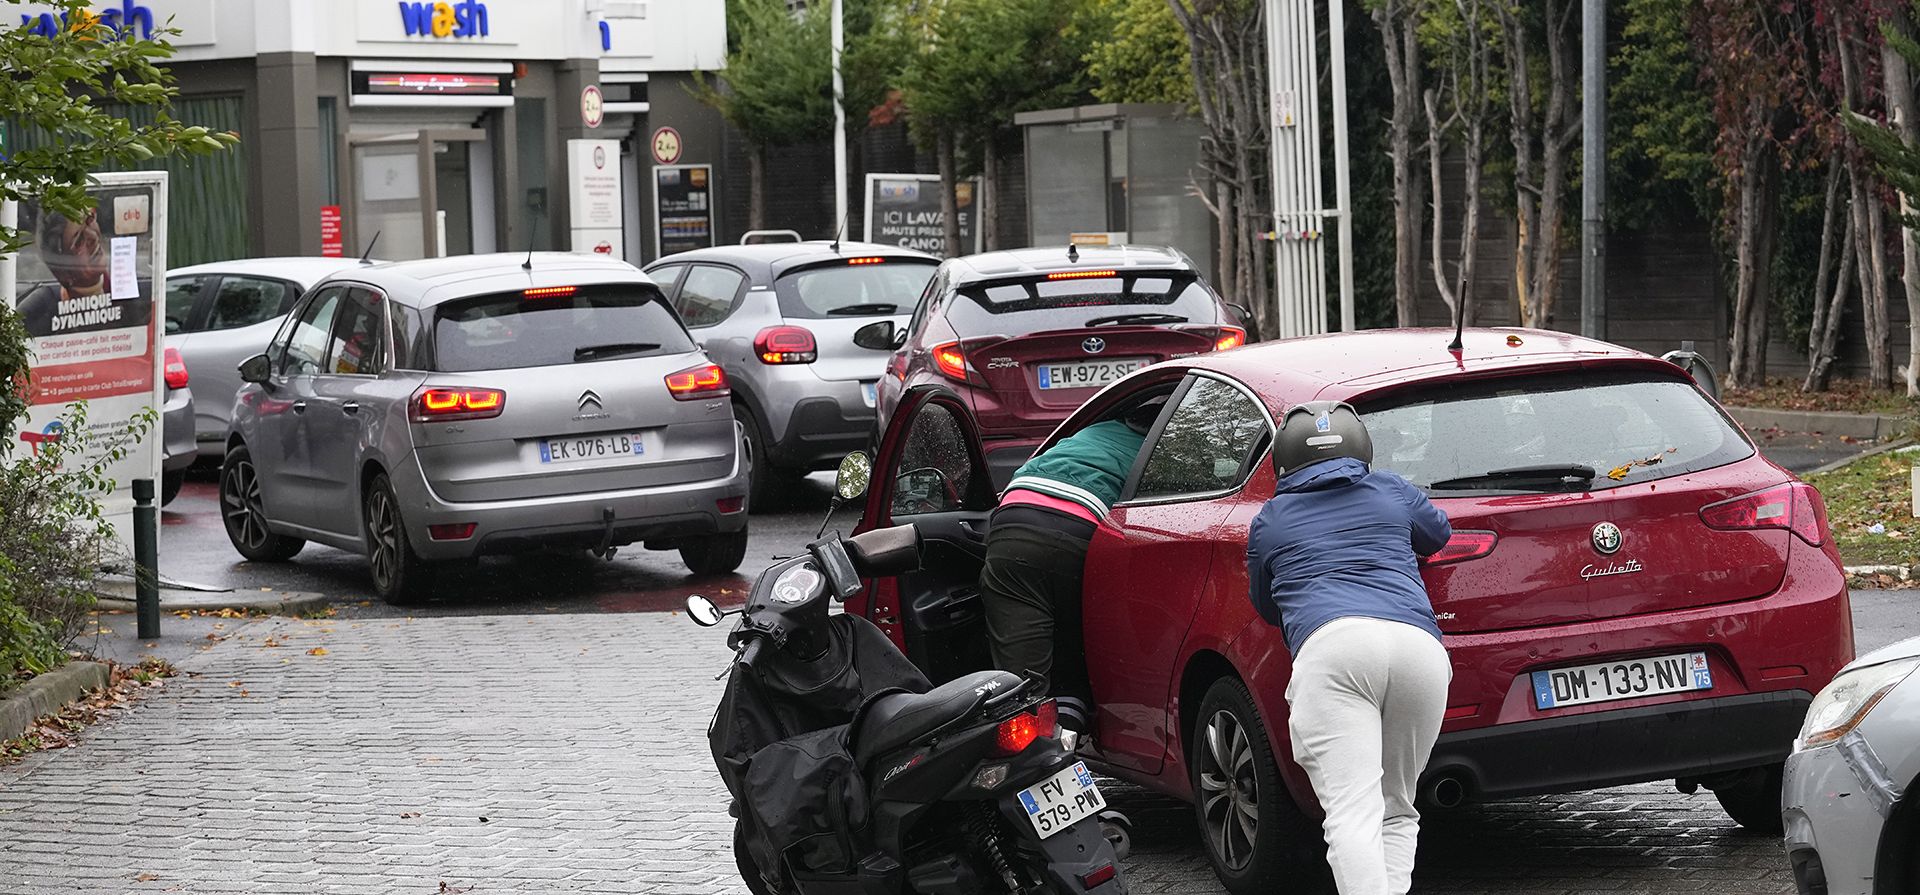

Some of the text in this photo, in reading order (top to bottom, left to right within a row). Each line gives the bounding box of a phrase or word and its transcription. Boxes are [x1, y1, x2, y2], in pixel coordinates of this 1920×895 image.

[399, 0, 489, 38] wash
[884, 211, 968, 225] ICI LAVAE
[882, 226, 916, 236] HAUTE
[58, 293, 112, 315] MONIQUE
[51, 306, 121, 331] DYNAMIQUE
[551, 436, 631, 460] EK-076-LB
[1580, 558, 1643, 582] Giulietta
[975, 680, 1001, 697] SYM
[1551, 657, 1689, 702] DM-133-NV
[1695, 671, 1711, 686] 75
[1541, 693, 1547, 702] F
[1079, 774, 1092, 786] 75
[1037, 788, 1100, 832] 579-PW
